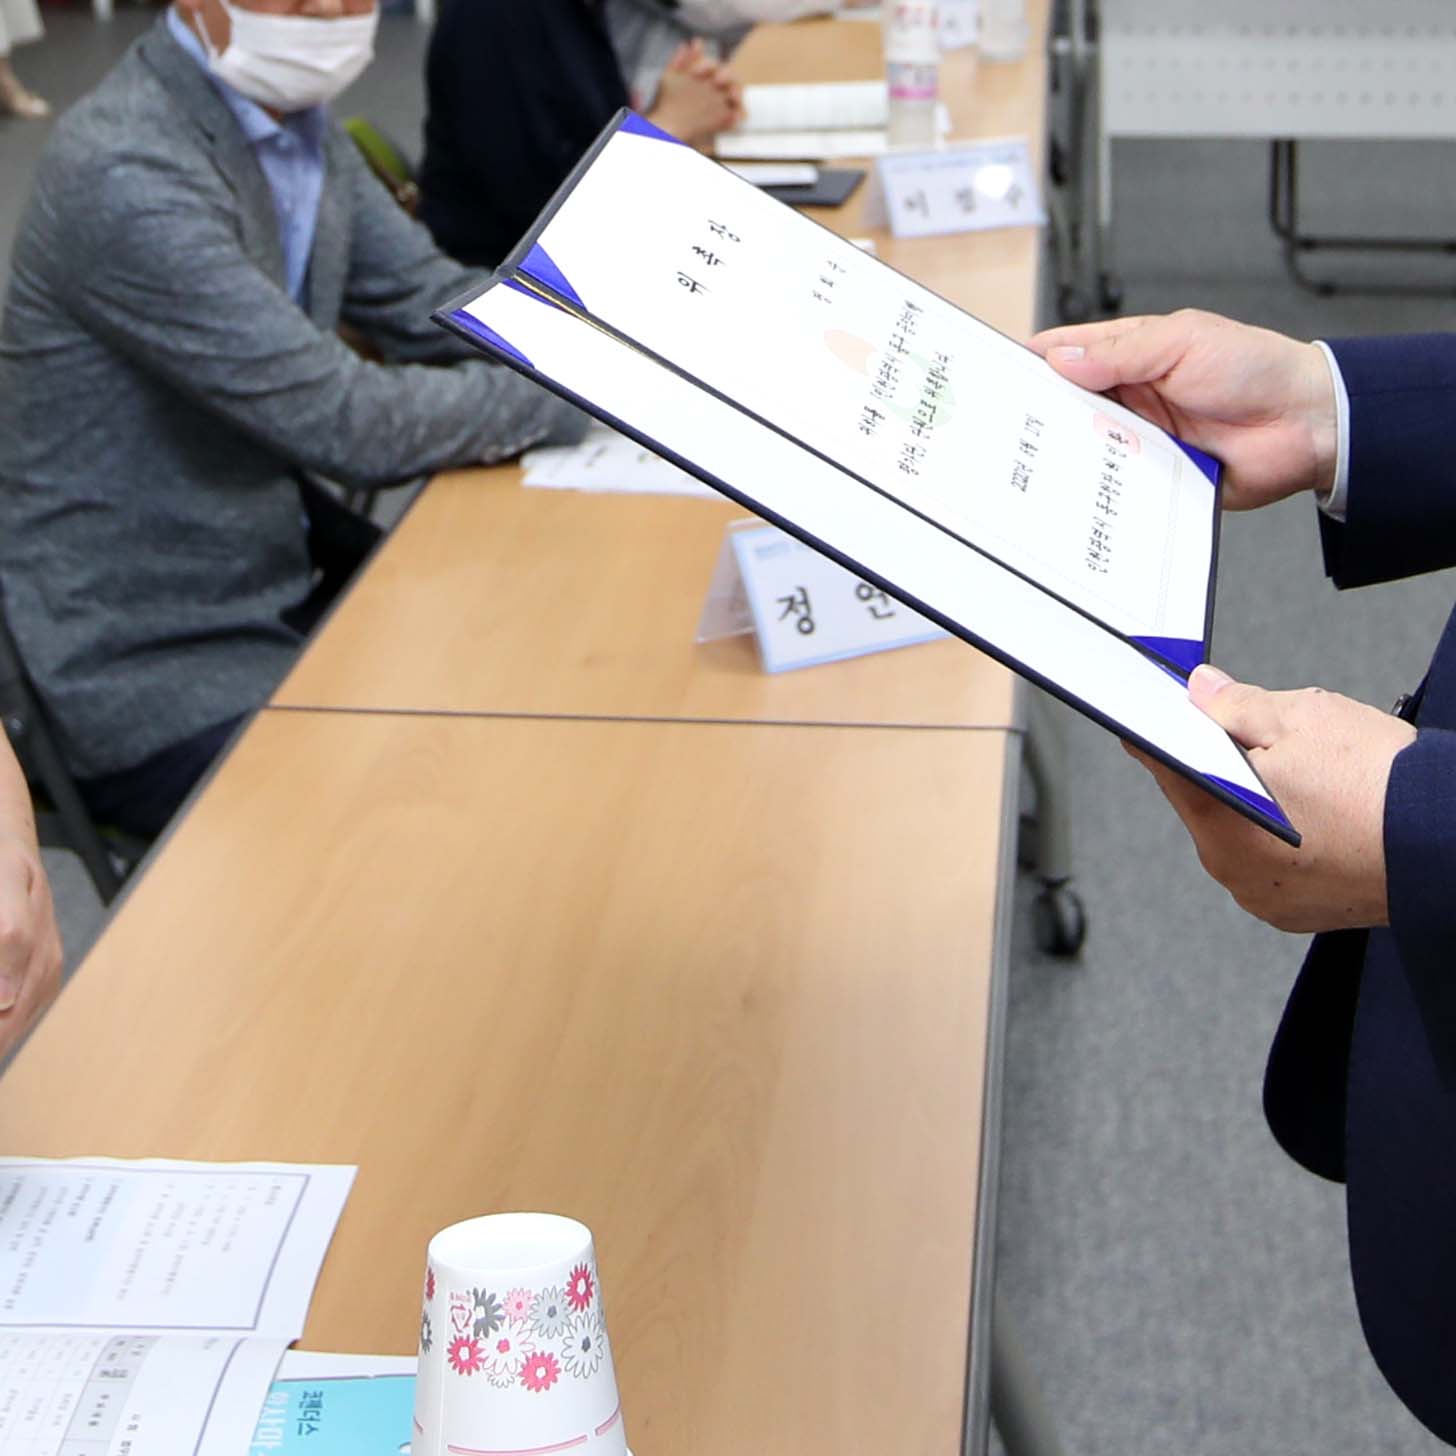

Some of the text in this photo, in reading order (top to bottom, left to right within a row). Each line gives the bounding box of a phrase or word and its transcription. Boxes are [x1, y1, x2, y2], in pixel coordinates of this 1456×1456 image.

[1096, 472, 1122, 516] 동구청장
[1085, 516, 1111, 573] 인천광역시
[776, 586, 815, 635] 정
